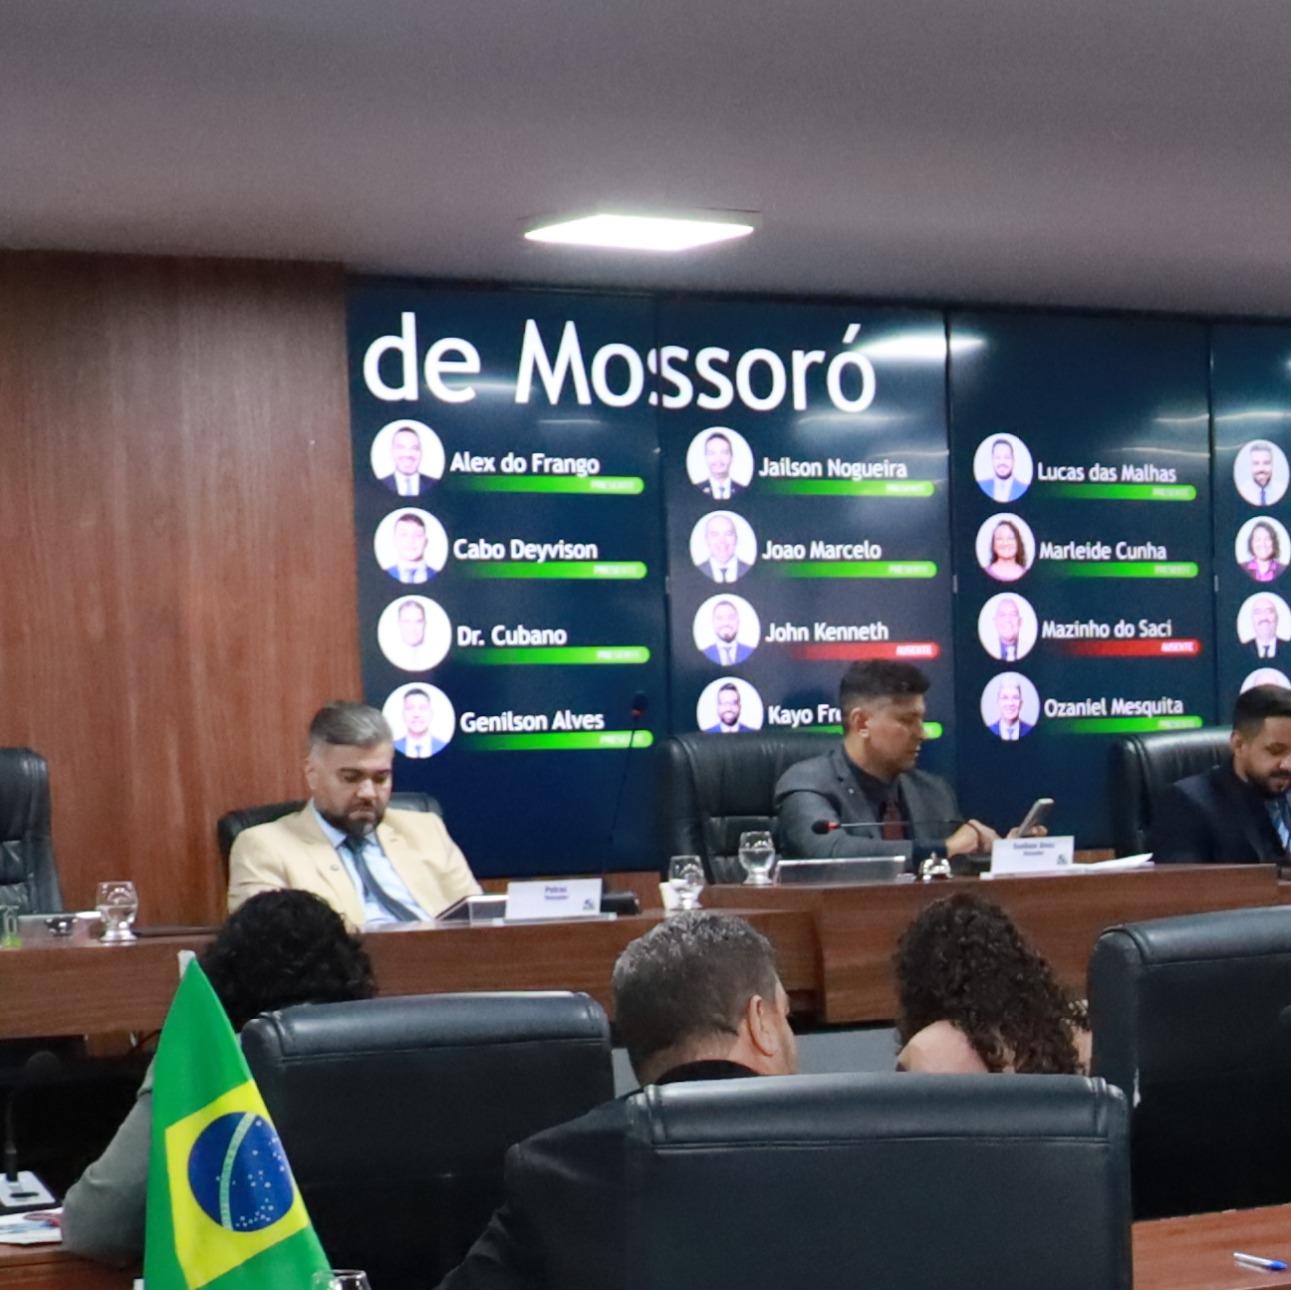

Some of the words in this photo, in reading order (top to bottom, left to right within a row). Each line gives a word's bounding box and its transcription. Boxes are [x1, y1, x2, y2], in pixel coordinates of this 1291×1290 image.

[363, 312, 480, 403] de
[514, 318, 876, 413] Mossoró
[450, 452, 496, 472] Alex
[501, 452, 527, 473] do
[532, 453, 600, 478] Frango
[758, 457, 822, 477] Jailson
[827, 458, 908, 481] Nogueira
[1038, 462, 1085, 482] Lucas
[1089, 462, 1117, 481] das
[1121, 463, 1177, 483] Malhas
[453, 539, 505, 560] Cabo
[510, 539, 598, 564] Deyvison
[762, 540, 806, 559] Joao
[810, 540, 882, 560] Marcelo
[1039, 541, 1111, 560] Marleide
[1116, 541, 1167, 560] Cunha
[457, 626, 485, 646] Dr.
[491, 625, 568, 646] Cubano
[765, 622, 809, 642] John
[814, 621, 888, 641] Kenneth
[1042, 619, 1110, 638] Mazinho
[1114, 619, 1135, 638] do
[1139, 619, 1172, 638] Saci
[768, 705, 813, 728] Kayo
[1044, 698, 1107, 717] Ozaniel
[1110, 697, 1184, 718] Mesquita
[460, 711, 548, 733] Genilson
[552, 709, 605, 731] Alves
